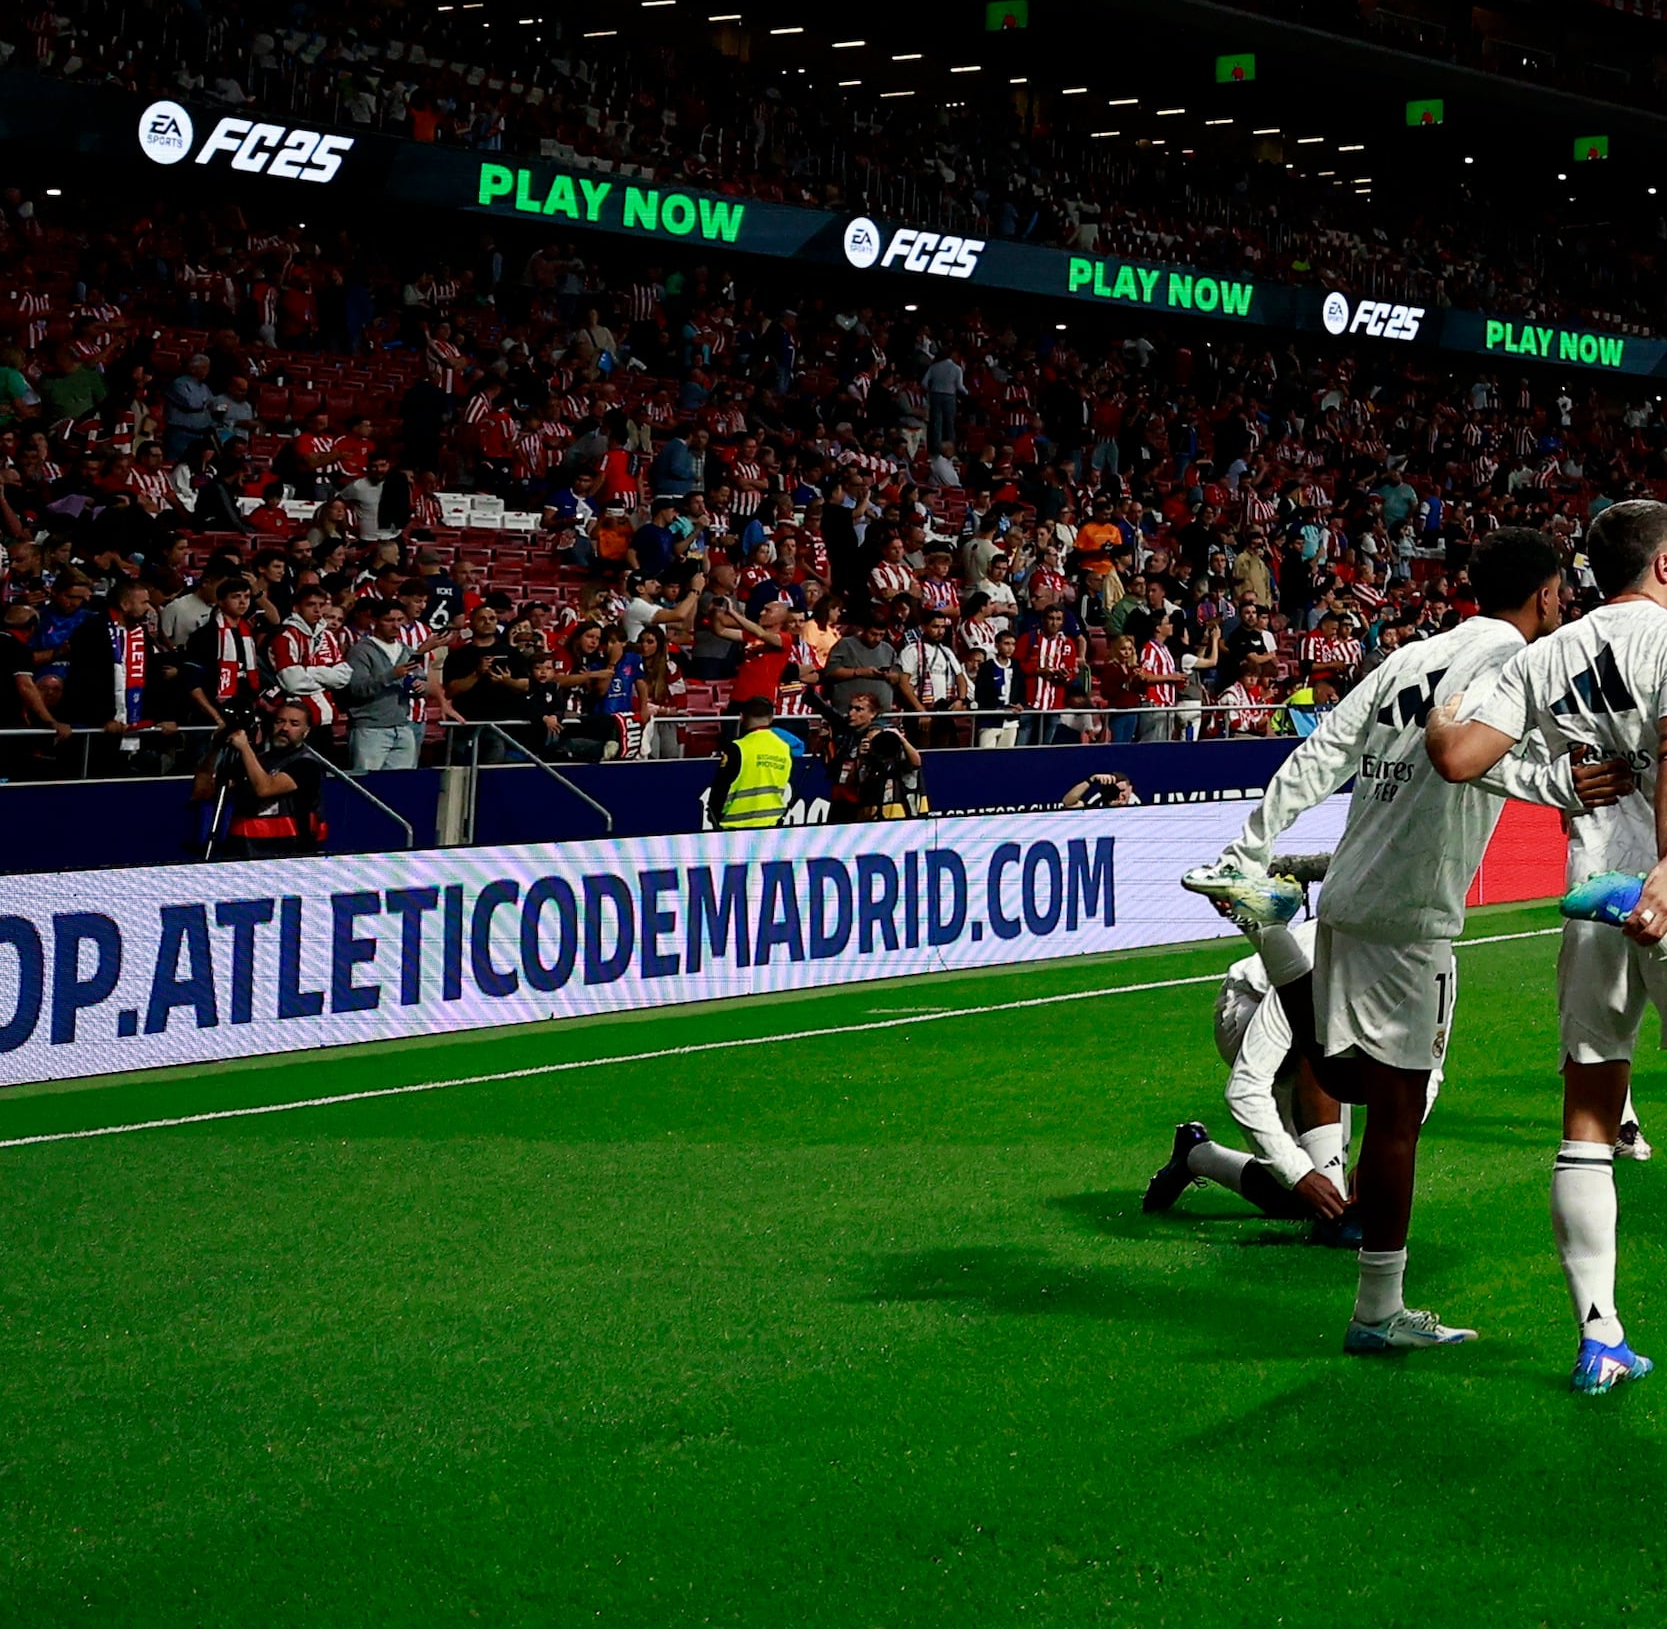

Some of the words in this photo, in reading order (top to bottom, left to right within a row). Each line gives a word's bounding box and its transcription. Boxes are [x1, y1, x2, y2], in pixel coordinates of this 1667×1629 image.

[147, 133, 183, 149] SPORTS
[151, 114, 182, 137] EA
[195, 117, 355, 183] FC25
[479, 162, 612, 222] PLAY
[624, 186, 745, 243] NOW
[880, 228, 986, 279] FC25
[1068, 257, 1161, 303] PLAY
[1167, 272, 1254, 316] NOW
[1349, 300, 1426, 341] FC25
[1486, 319, 1554, 357] PLAY
[1559, 331, 1624, 367] NOW
[429, 600, 449, 630] 6
